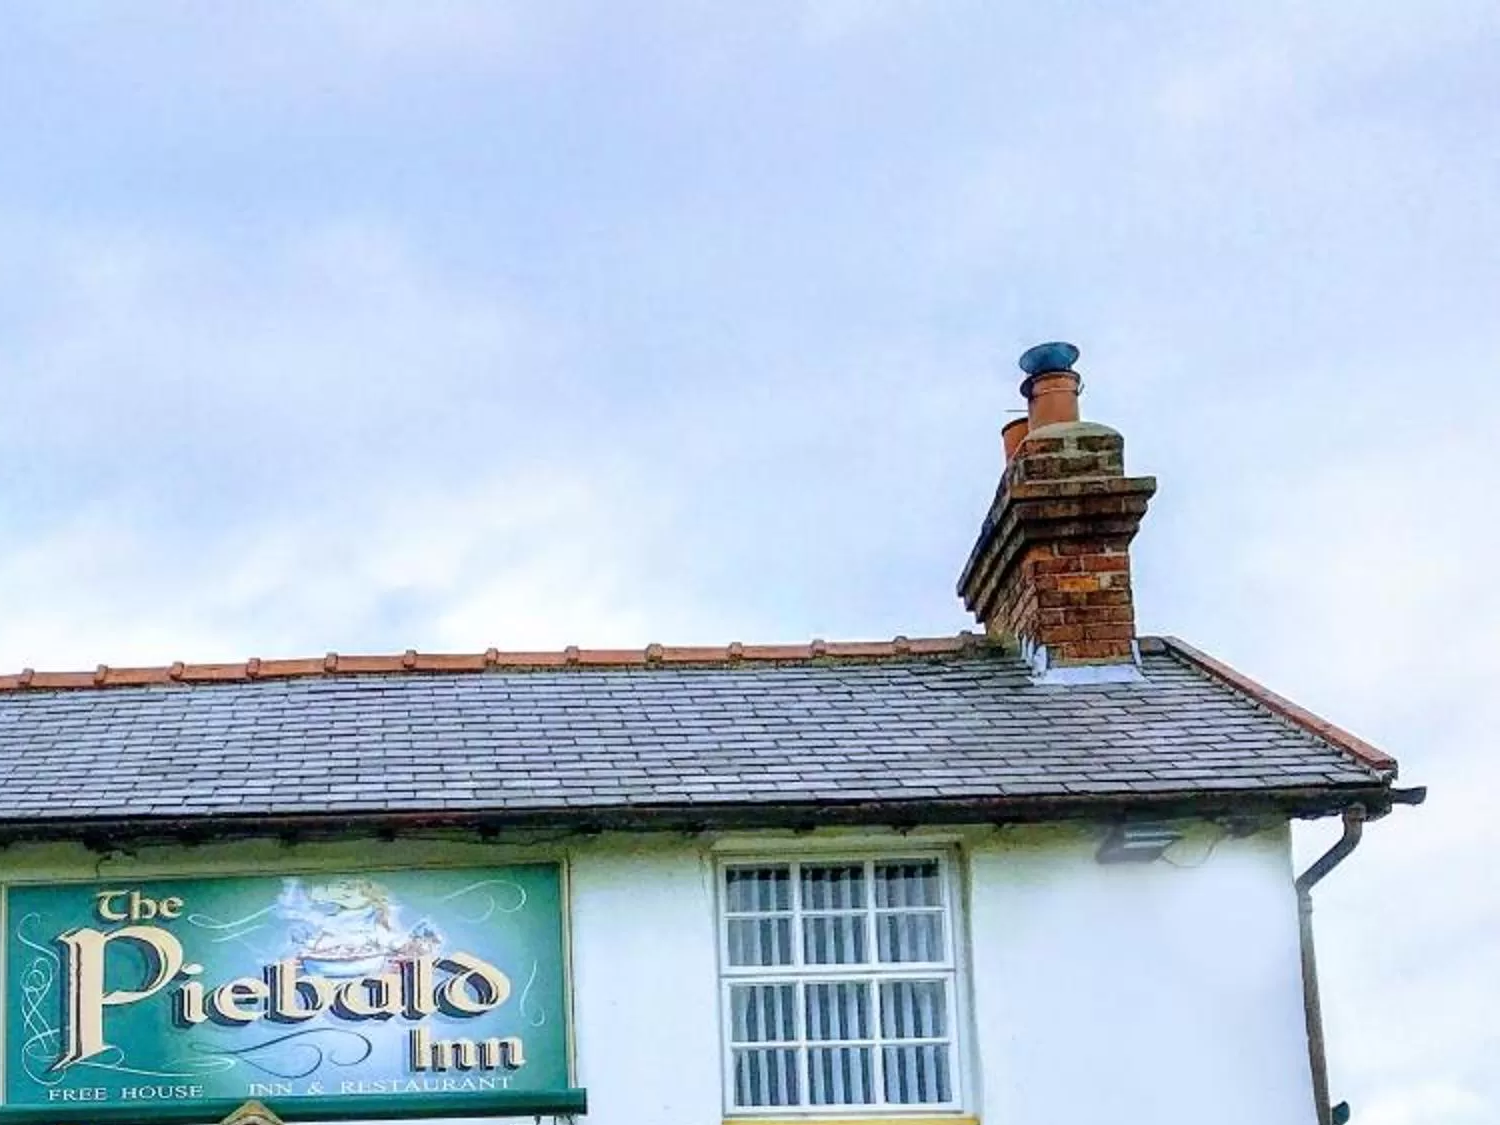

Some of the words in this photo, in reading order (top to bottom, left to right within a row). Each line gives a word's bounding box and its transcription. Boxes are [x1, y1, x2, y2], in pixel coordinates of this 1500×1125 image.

[96, 889, 184, 922] The
[48, 925, 511, 1071] Piebald
[410, 1024, 526, 1072] Inn
[49, 1087, 107, 1101] FREE
[120, 1084, 204, 1099] HOUSE
[248, 1082, 293, 1097] INN
[307, 1081, 324, 1095] &
[340, 1075, 512, 1095] RESTAURANT
